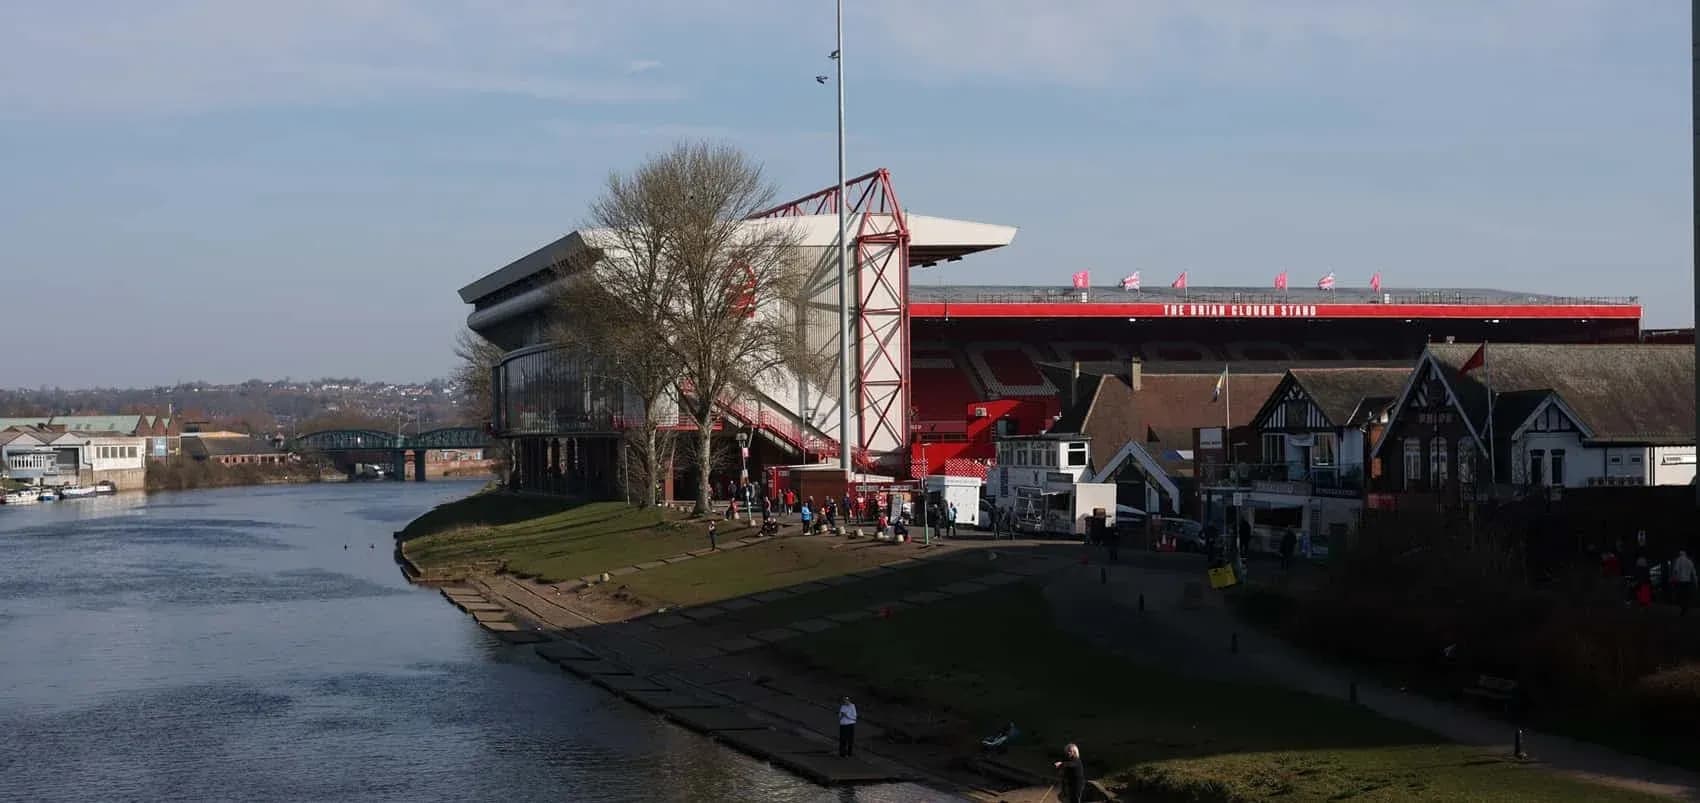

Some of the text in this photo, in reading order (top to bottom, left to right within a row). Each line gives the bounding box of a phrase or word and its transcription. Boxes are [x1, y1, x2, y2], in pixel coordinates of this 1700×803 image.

[1164, 305, 1317, 316] THE BRIAN CLOUGH STAND
